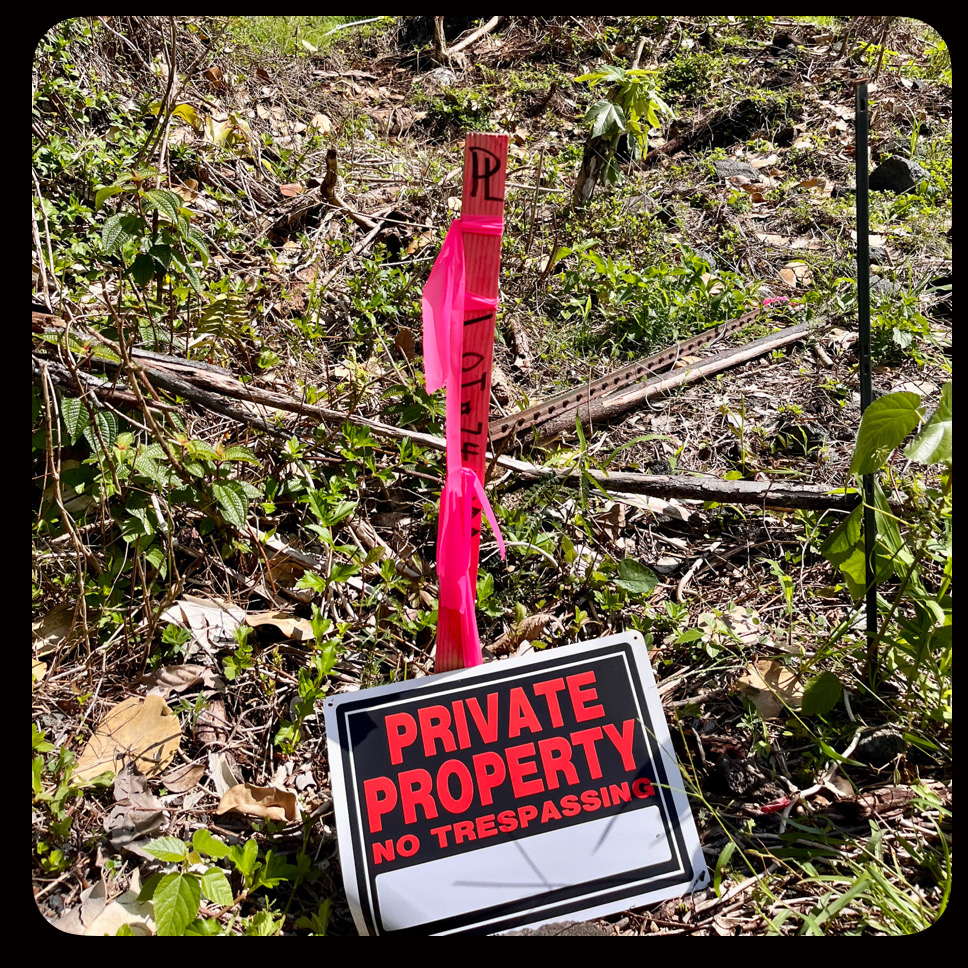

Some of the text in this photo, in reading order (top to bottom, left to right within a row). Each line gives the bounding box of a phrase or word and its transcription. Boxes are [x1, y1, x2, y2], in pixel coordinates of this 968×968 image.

[469, 146, 504, 203] PL
[384, 670, 605, 765] PRIVATE
[363, 718, 637, 833] PROPERTY
[372, 777, 656, 864] NO TRESPASSING
